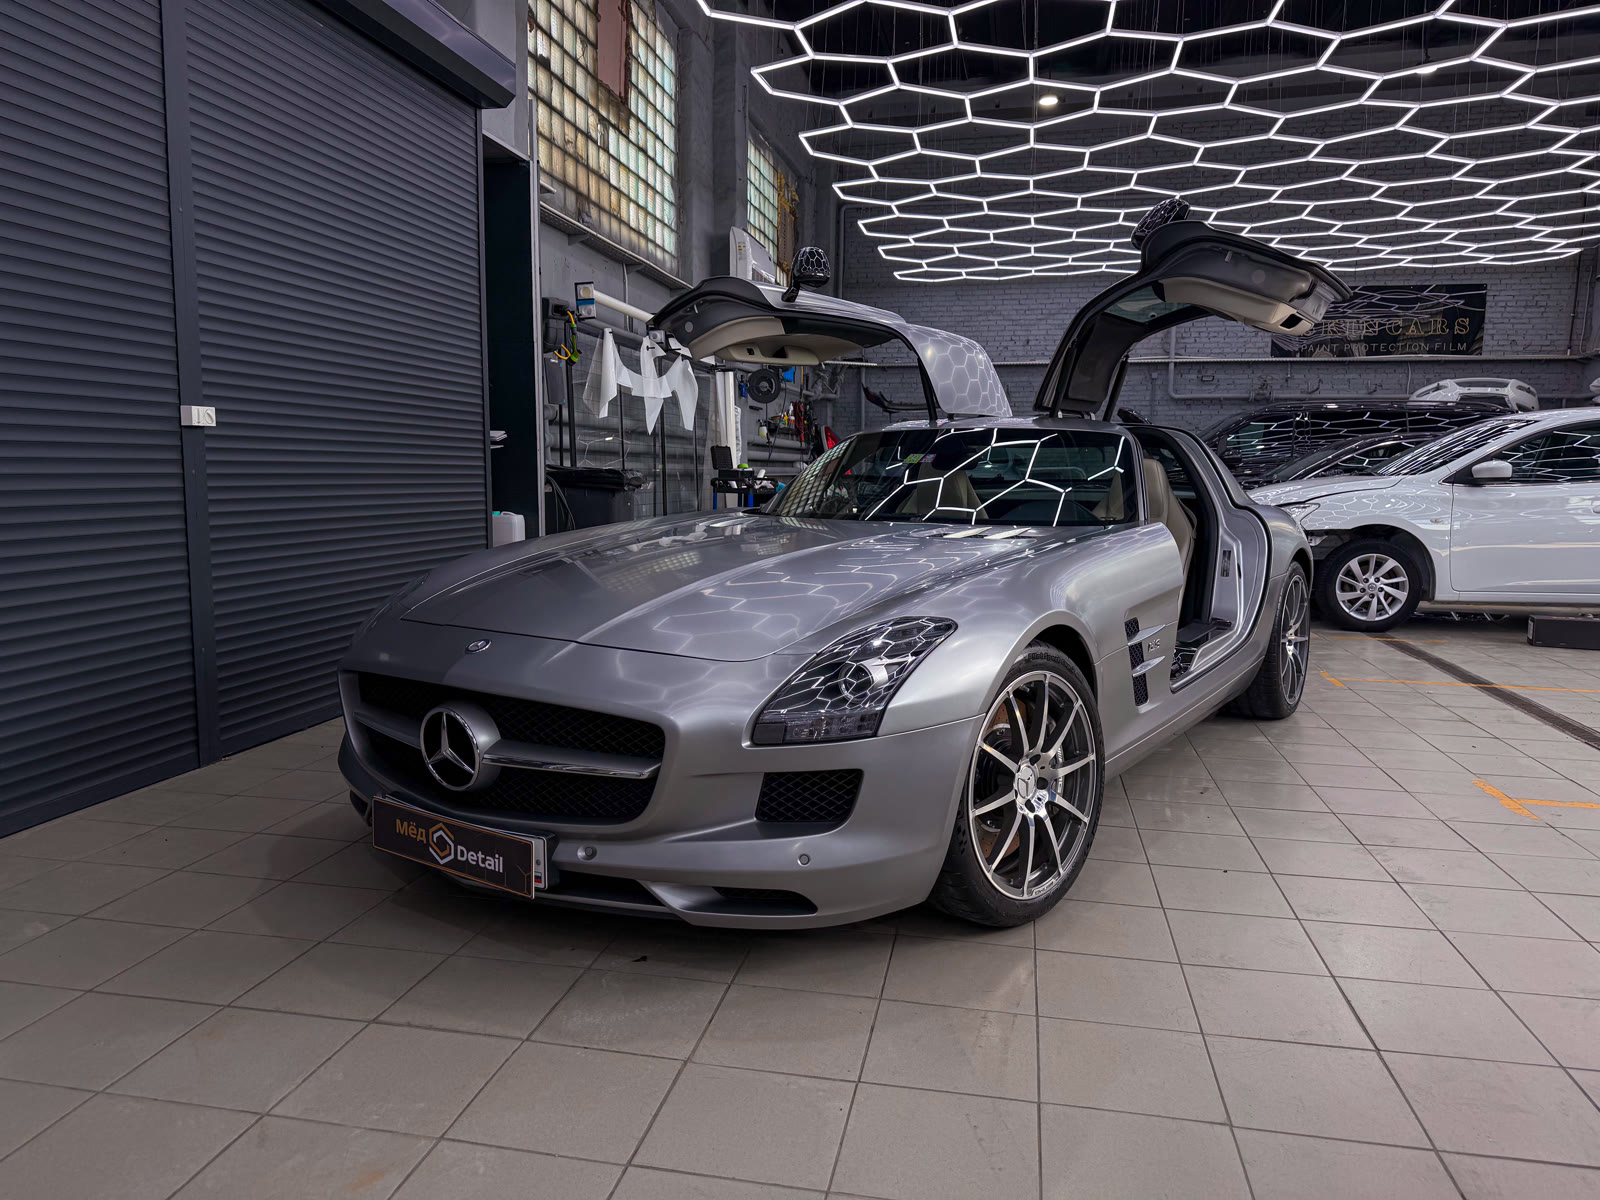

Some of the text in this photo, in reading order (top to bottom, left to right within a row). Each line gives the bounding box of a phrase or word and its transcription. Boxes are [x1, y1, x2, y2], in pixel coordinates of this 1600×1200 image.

[1301, 342, 1468, 353] PAINT PROTECTION FILM
[395, 818, 427, 844] Мёд
[456, 845, 503, 873] Detail
